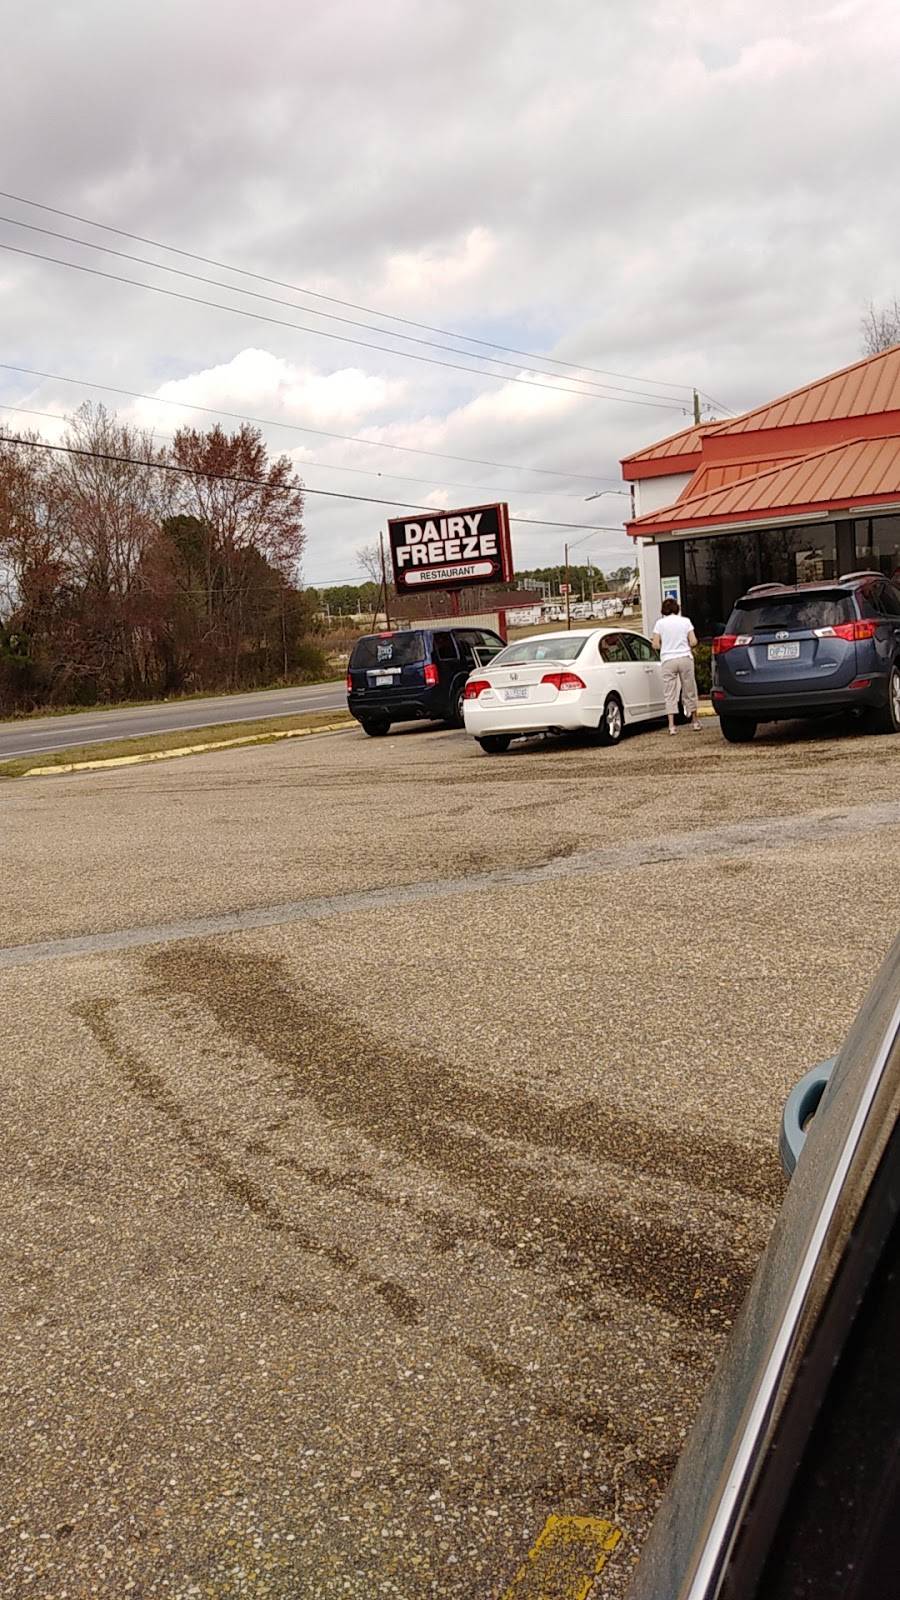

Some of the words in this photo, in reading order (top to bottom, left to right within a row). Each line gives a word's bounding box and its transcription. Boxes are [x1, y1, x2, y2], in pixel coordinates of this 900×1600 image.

[404, 513, 482, 544] DAIRY
[396, 533, 498, 567] FREEZE
[420, 566, 475, 580] RESTAURANT
